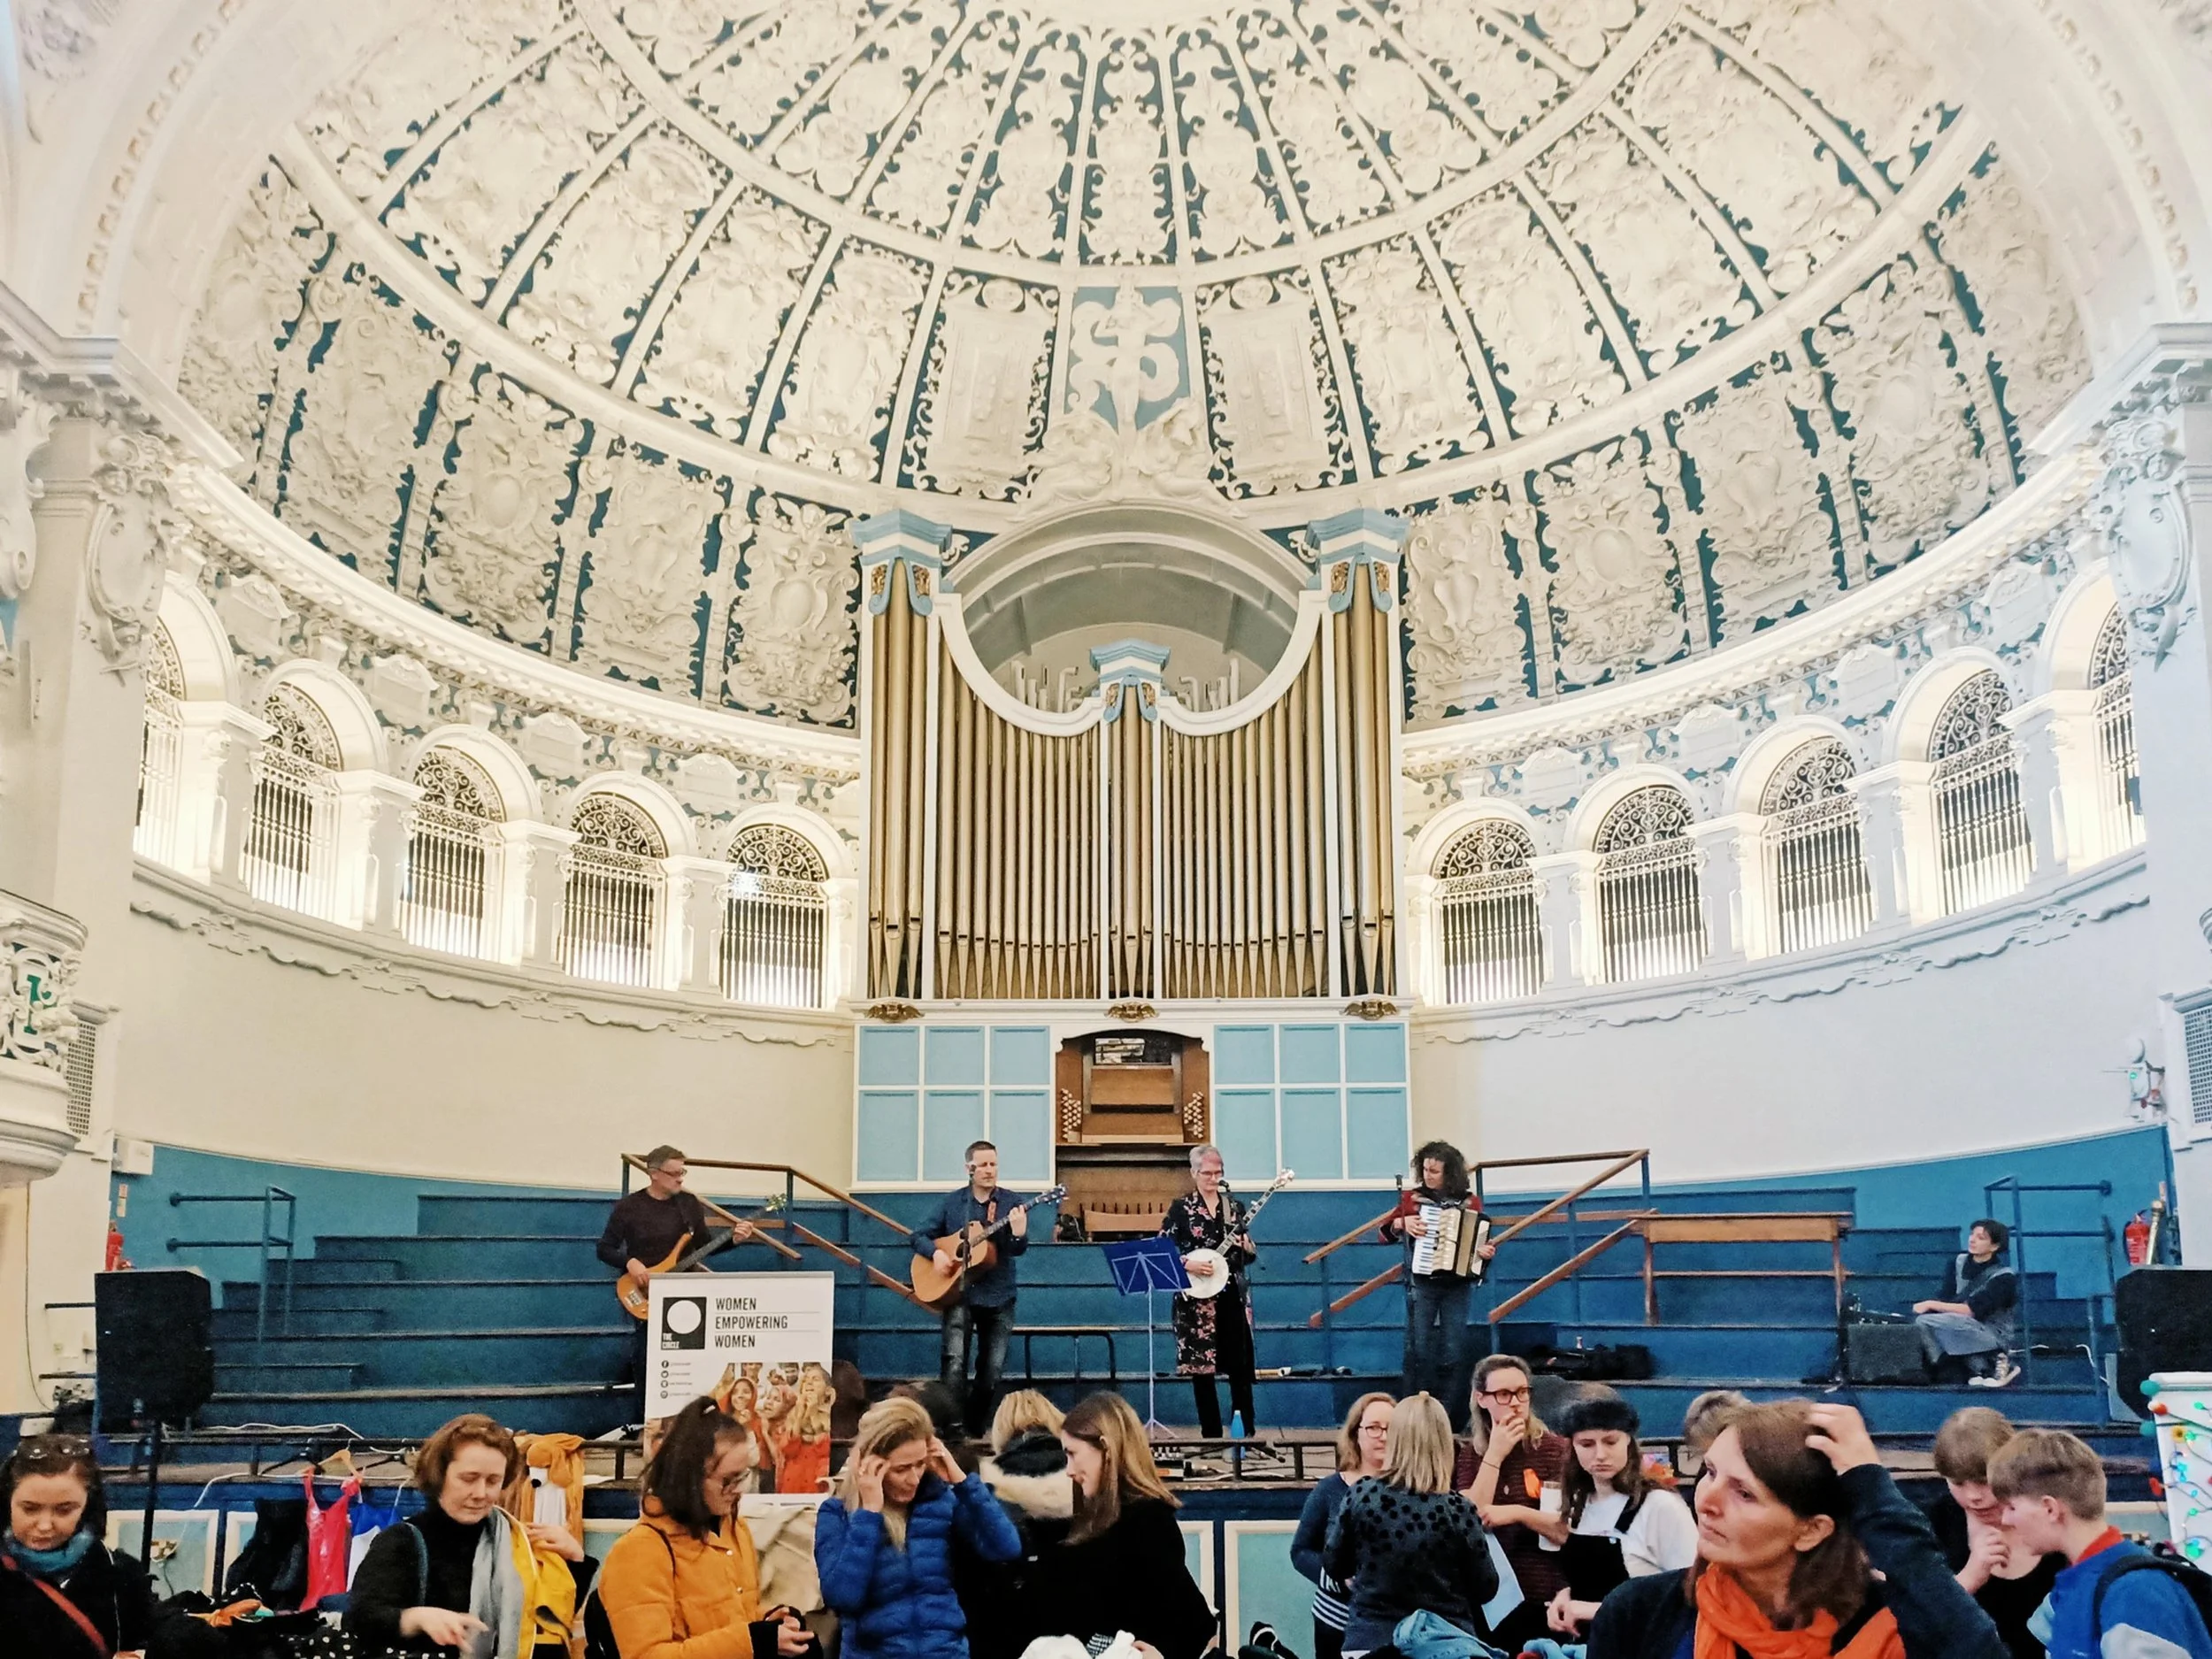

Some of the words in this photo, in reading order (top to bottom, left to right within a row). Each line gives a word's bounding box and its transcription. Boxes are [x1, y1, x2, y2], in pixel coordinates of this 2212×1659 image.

[716, 1297, 757, 1310] WOMEN
[715, 1316, 788, 1329] EMPOWERING
[714, 1334, 756, 1348] WOMEN
